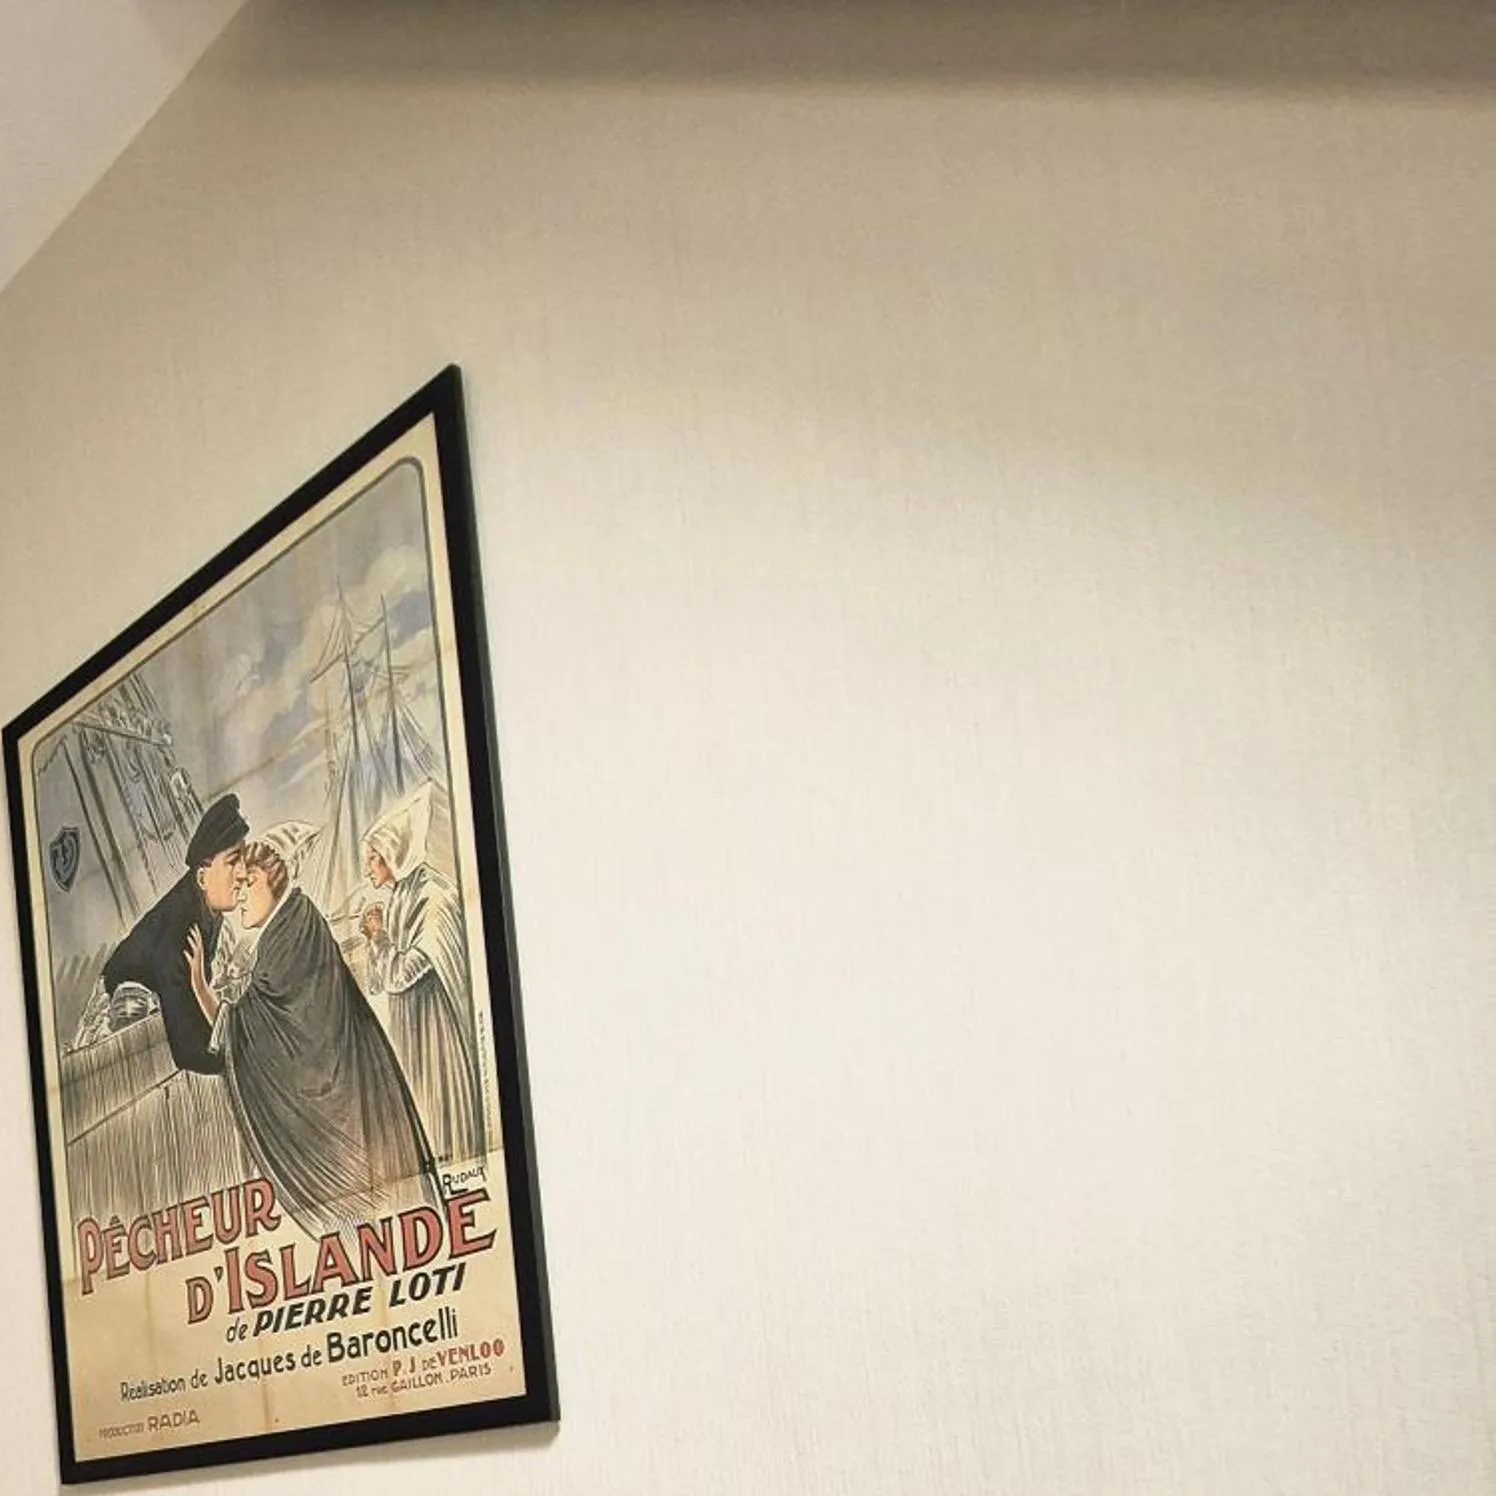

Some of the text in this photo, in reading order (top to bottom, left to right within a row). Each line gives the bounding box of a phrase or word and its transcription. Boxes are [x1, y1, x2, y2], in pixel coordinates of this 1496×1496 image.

[77, 1177, 282, 1296] PÊCHEUR
[185, 1187, 498, 1325] D'ISLANDE
[226, 1262, 467, 1343] de PIERRE LOTI
[190, 1368, 208, 1389] de
[214, 1351, 296, 1385] Jacques
[301, 1345, 323, 1368] de
[327, 1306, 459, 1364] Baroncelli
[437, 1338, 505, 1366] VENLOO
[147, 1409, 200, 1433] RADIA
